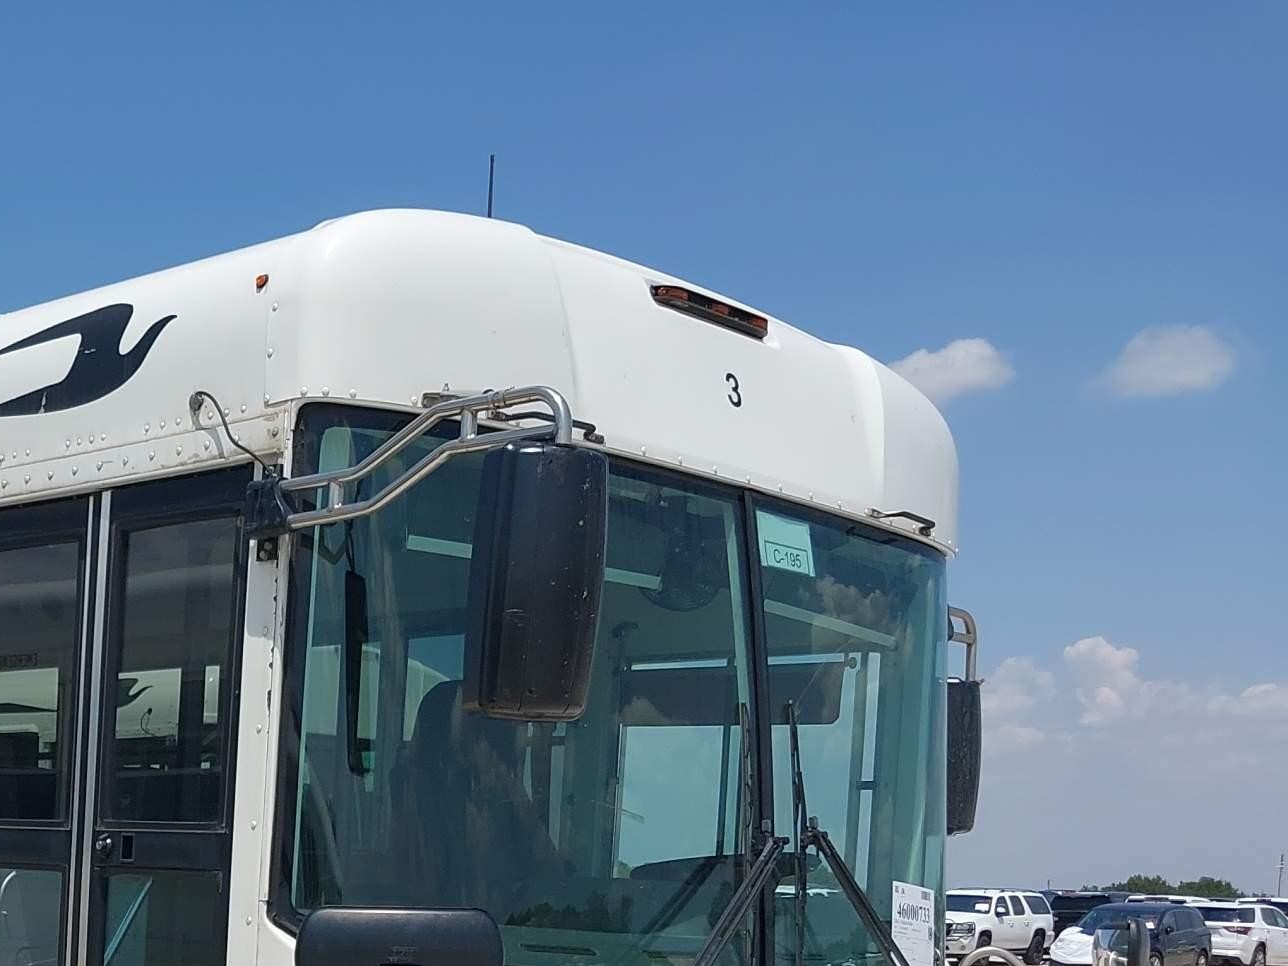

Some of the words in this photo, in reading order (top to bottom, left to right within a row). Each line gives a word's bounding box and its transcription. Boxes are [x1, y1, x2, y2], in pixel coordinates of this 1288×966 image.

[725, 372, 742, 408] 3
[773, 548, 802, 569] C-195
[897, 901, 930, 924] 46000733
